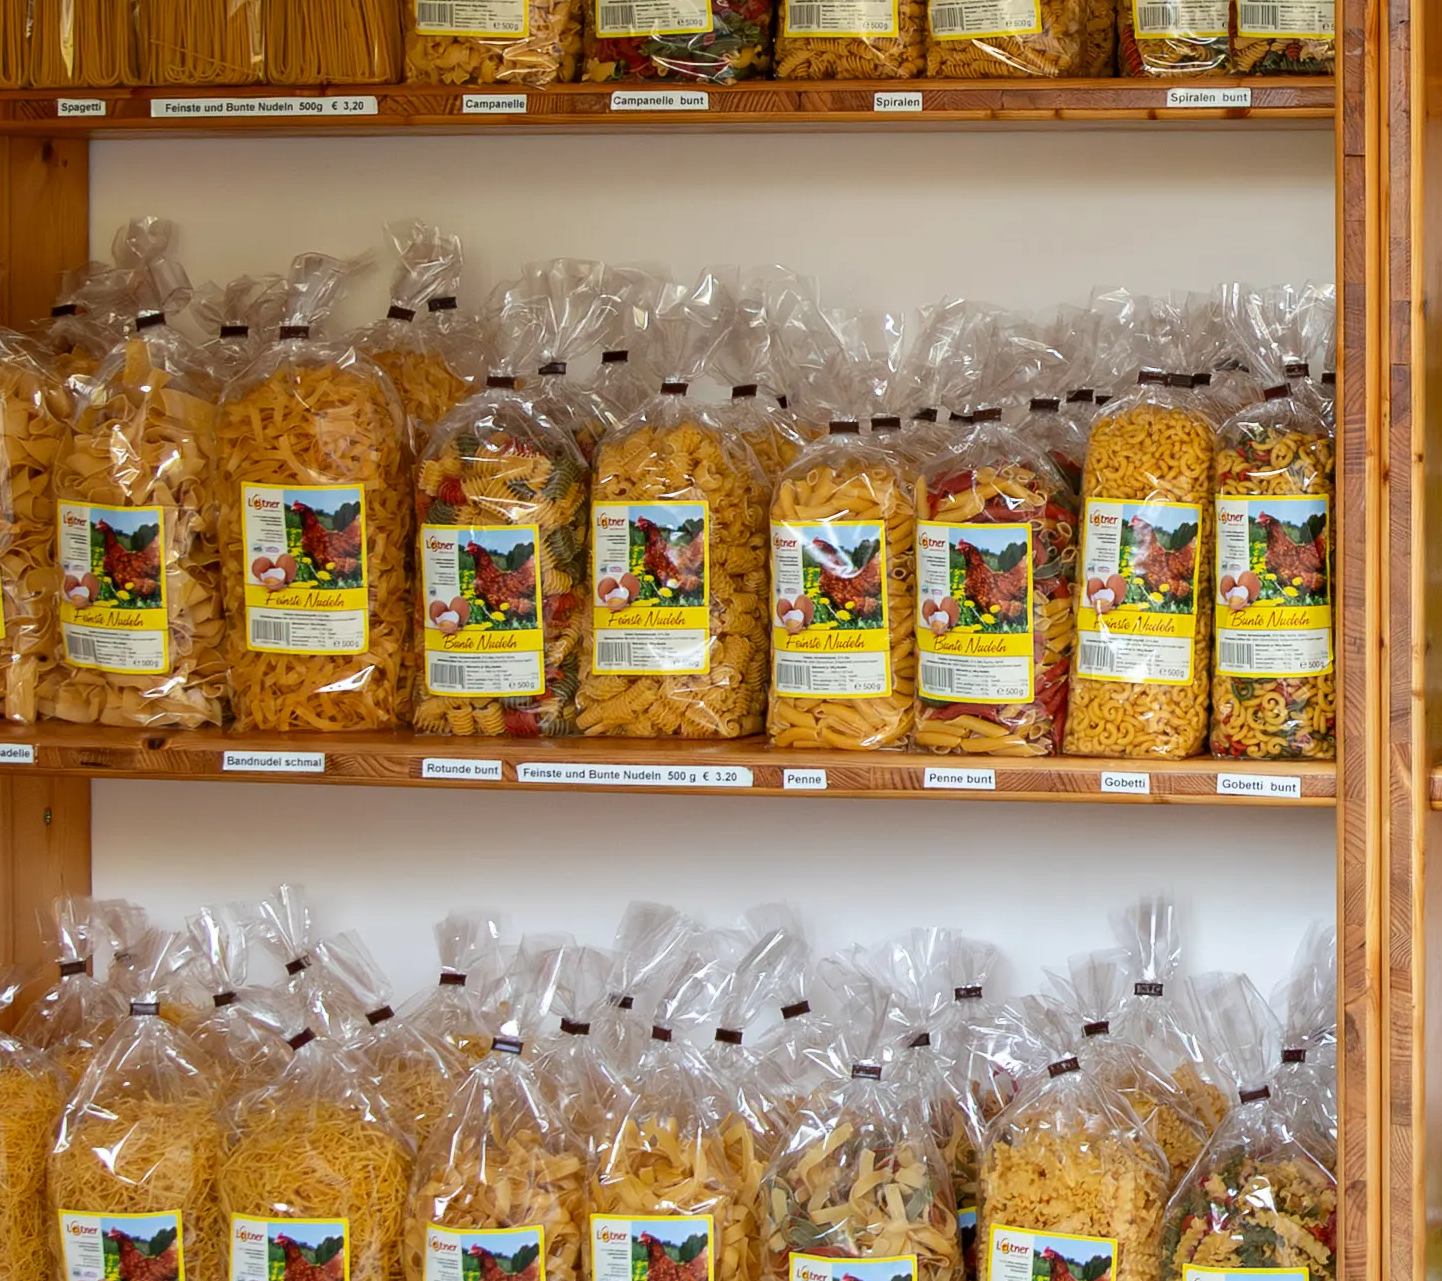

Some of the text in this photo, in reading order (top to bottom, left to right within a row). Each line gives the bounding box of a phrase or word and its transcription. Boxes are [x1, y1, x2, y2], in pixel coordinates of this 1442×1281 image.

[464, 98, 526, 111] Campanelle
[612, 95, 705, 107] Campanelle bunt
[875, 96, 921, 109] Spiralen
[1170, 92, 1248, 104] Spiralen bunt
[60, 101, 103, 115] Spagetti
[164, 102, 202, 114] Feinste
[203, 102, 224, 113] und
[225, 101, 256, 113] Bunte
[257, 101, 294, 112] Nudeln
[298, 101, 324, 113] 500g
[342, 100, 365, 112] 3,20
[265, 591, 346, 609] Feinste Nudeln
[226, 755, 322, 767] Bandnudel schmal
[426, 762, 499, 775] Rotunde bunt
[522, 767, 563, 779] Feinste
[564, 769, 586, 779] und
[588, 769, 621, 780] Bunte
[623, 770, 662, 781] Nudeln
[667, 770, 687, 782] 500
[715, 771, 738, 782] 3.20
[787, 773, 822, 785] Penne
[928, 772, 993, 785] Penne bunt
[1104, 776, 1146, 789] Gobetti
[1221, 778, 1297, 793] Gobetti bunt
